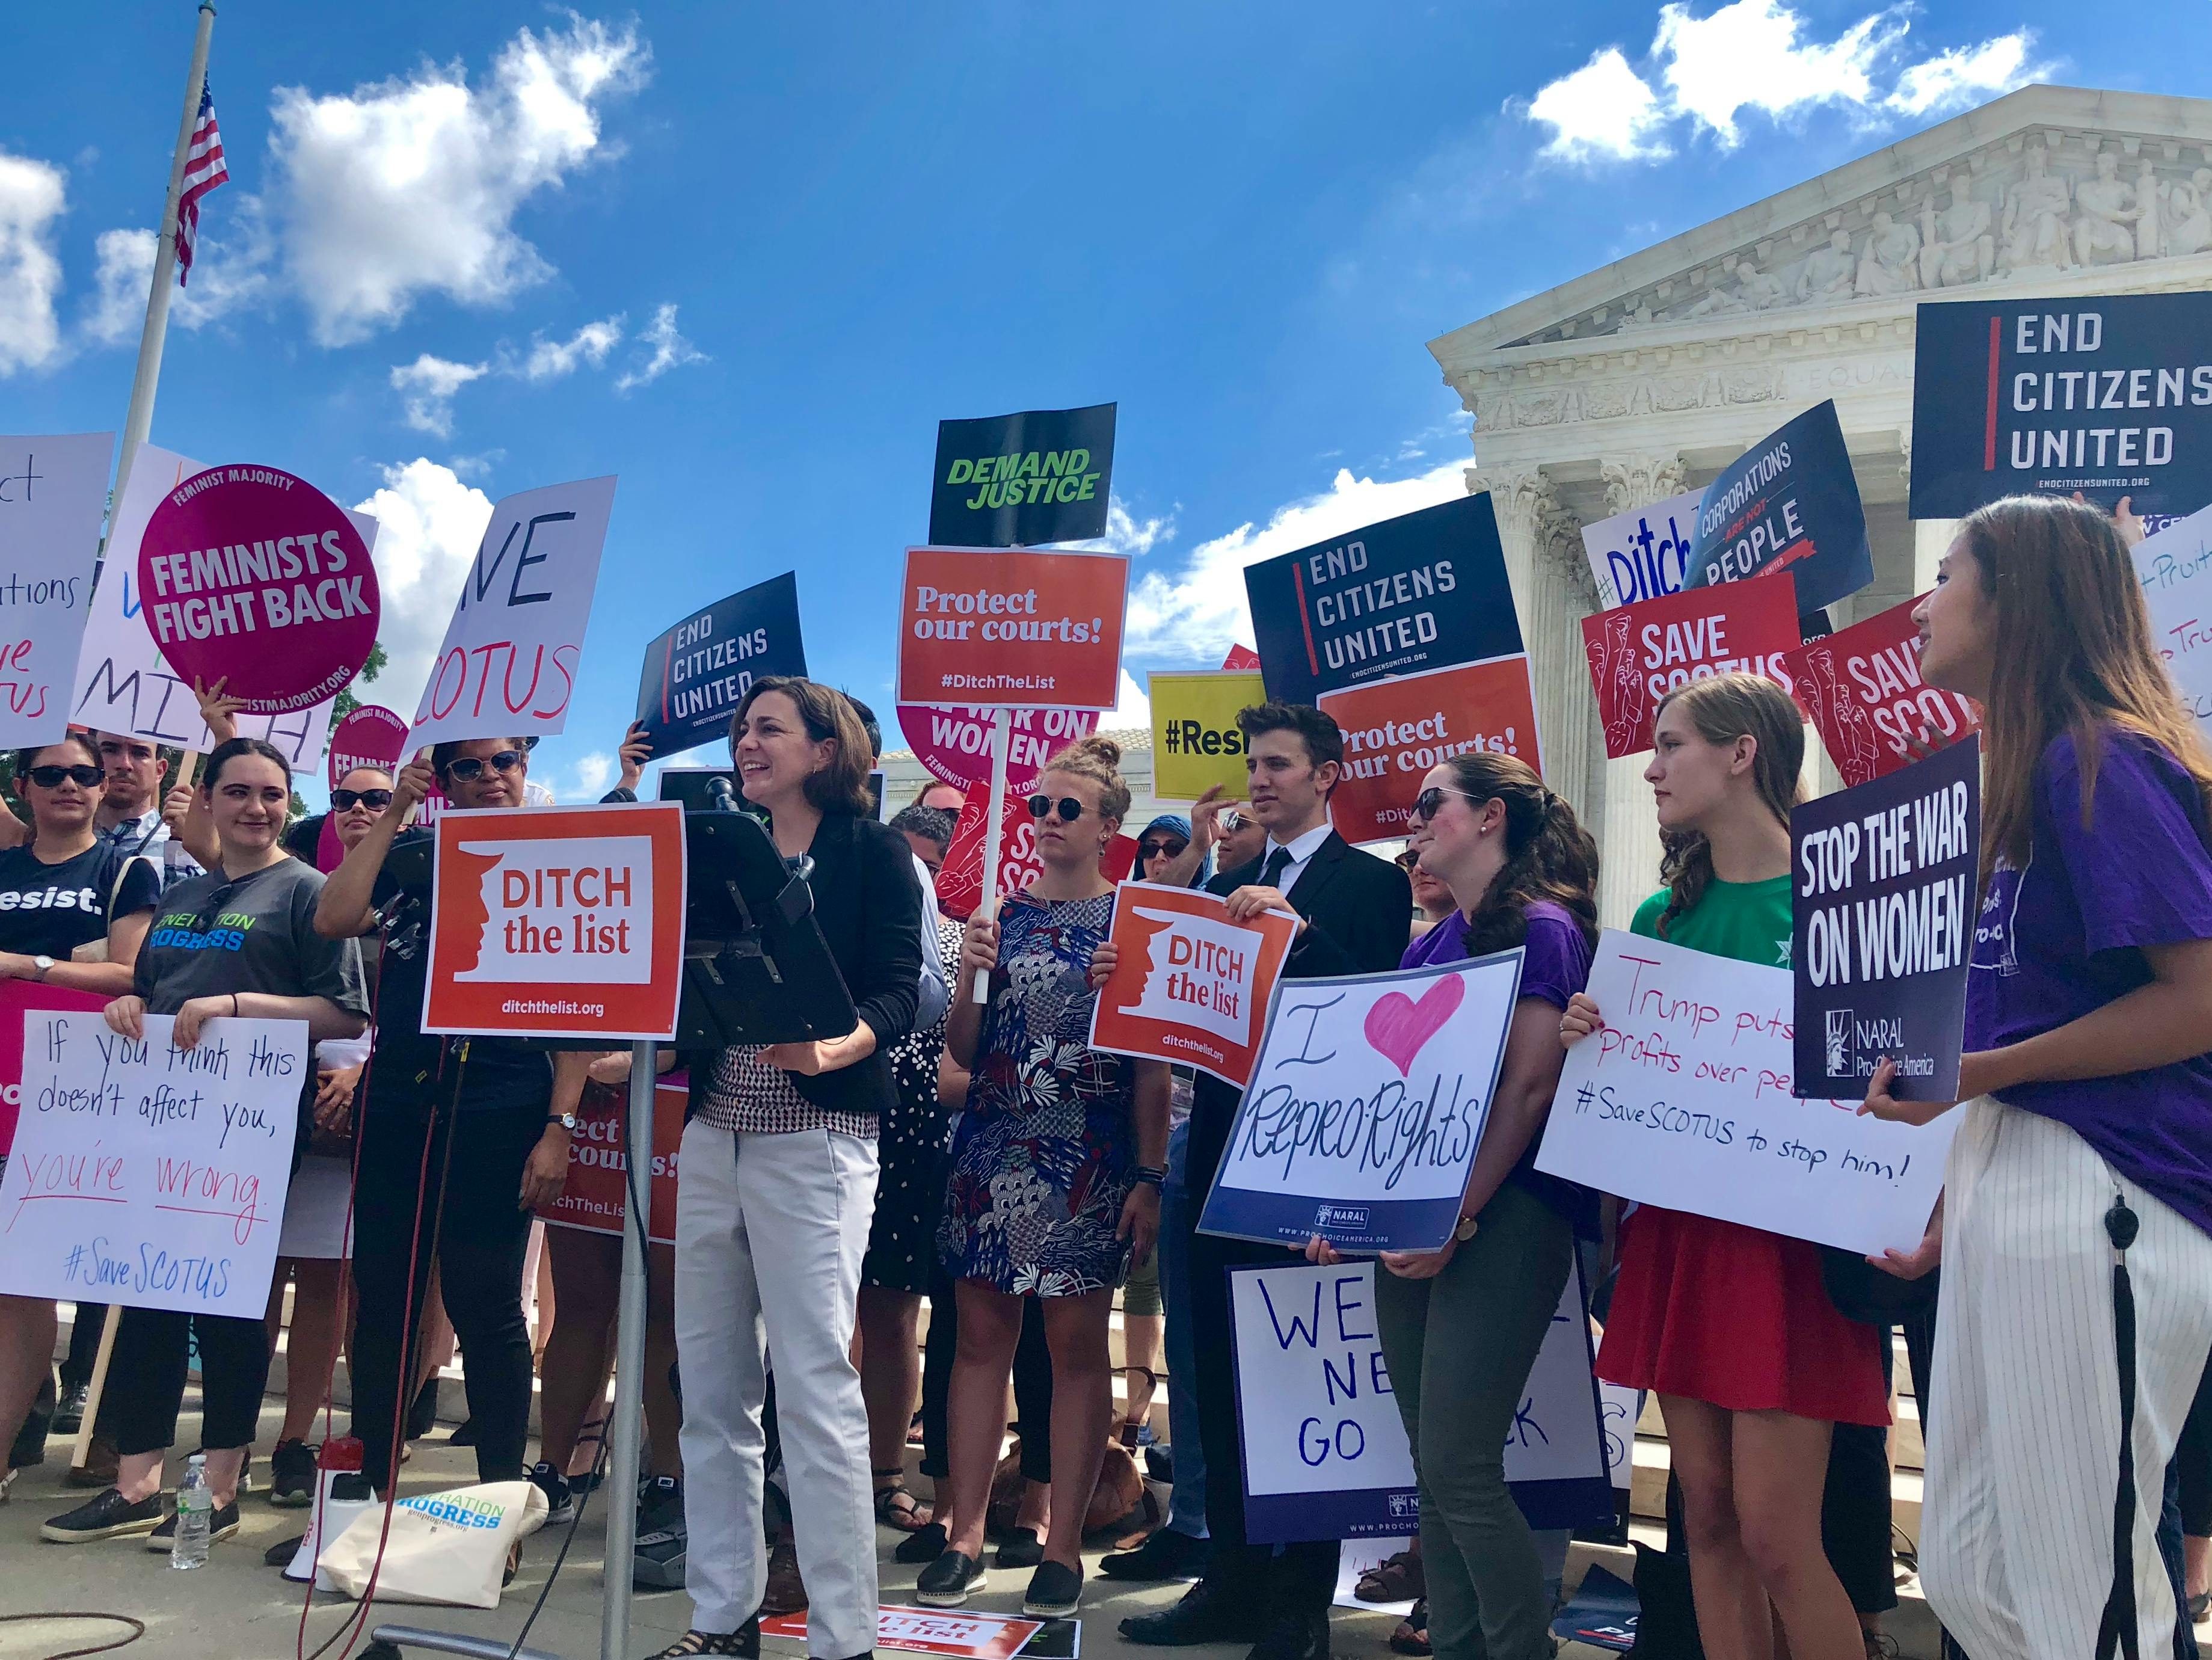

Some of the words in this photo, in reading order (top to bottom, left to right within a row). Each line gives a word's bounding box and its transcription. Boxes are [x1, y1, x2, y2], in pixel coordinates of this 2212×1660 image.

[2017, 312, 2103, 353] END
[1810, 361, 1915, 389] EQUAL
[2013, 365, 2212, 412] CITIZENS
[946, 449, 1090, 484] DEMAND
[2011, 426, 2174, 469] UNITED
[173, 471, 224, 507] FEMINIST
[229, 468, 295, 491] MAJORITY
[966, 472, 1101, 510] JUSTICE
[1701, 441, 1792, 540] CORPORATIONS
[2038, 477, 2150, 489] ENDCITIZENSUNITED.ORG
[1724, 518, 1744, 543] ARE
[1747, 497, 1767, 523] NOT
[461, 512, 576, 611] VE
[1706, 497, 1805, 586] PEOPLE
[150, 530, 348, 596] FEMINISTS
[1310, 541, 1368, 585] END
[1764, 557, 1784, 576] UNITED
[153, 591, 256, 644] FIGHT
[262, 575, 372, 629] BACK
[915, 586, 1037, 615] Protect
[1316, 560, 1456, 627] CITIZENS
[677, 613, 713, 650] END
[914, 619, 974, 641] our
[982, 617, 1102, 644] courts!
[1324, 611, 1438, 669] UNITED
[1641, 613, 1730, 669] SAVE
[2169, 618, 2212, 653] Tru
[674, 628, 768, 684] CITIZENS
[1351, 653, 1428, 679] ENDCITIZENSUNITED.ORG
[1847, 636, 1923, 704] SAV
[218, 664, 351, 712] ISTMAJORITY.ORG
[415, 641, 580, 727] OTUS
[674, 671, 754, 719] UNITED
[941, 674, 1055, 690] #DitchTheList
[349, 708, 375, 725] FEMINIST
[375, 709, 404, 732] MAJORITY
[692, 708, 737, 727] ENDCITIZENSUNITED
[1044, 710, 1089, 741] ON
[1166, 719, 1250, 755] #Res
[1873, 689, 1980, 753] SCO
[1338, 754, 1389, 782] our
[1801, 822, 1860, 898] STOP
[1864, 802, 1912, 883] THE
[1915, 781, 1968, 869] WAR
[0, 887, 102, 915] esist.
[503, 867, 631, 908] DITCH
[503, 914, 563, 954] the
[573, 913, 631, 954] list
[1807, 904, 1851, 988] ON
[1857, 873, 1965, 982] WOMEN
[1168, 935, 1244, 984] DITCH
[502, 1000, 604, 1017] ditchthelist.org
[1167, 972, 1209, 1007] the
[1212, 981, 1240, 1020] list
[1618, 954, 1720, 1039] Trump
[1731, 1008, 1794, 1047] puts
[1163, 1034, 1224, 1063] ditchthelist.org
[1275, 992, 1347, 1070] I
[1856, 1017, 1904, 1050] NARAL
[48, 1019, 69, 1063] If
[96, 1034, 148, 1091] you
[166, 1034, 230, 1080] think
[249, 1034, 295, 1077] this
[1695, 1062, 1748, 1083] over
[1857, 1054, 1903, 1077] Pro-Cce
[1903, 1053, 1934, 1075] America
[38, 1075, 124, 1116] doesn't
[139, 1084, 204, 1127] affect
[223, 1102, 276, 1149] you,
[1575, 1080, 1735, 1145] #SaveSCOTUS
[1747, 1128, 1767, 1152] to
[1777, 1139, 1828, 1173] stop
[1841, 1149, 1911, 1187] him!
[568, 1144, 678, 1178] cous!
[6, 1140, 125, 1233] you're
[552, 1195, 625, 1218] chTheLis
[1333, 1210, 1365, 1222] NARAL
[64, 1237, 232, 1299] #SaveSCOTUS
[1257, 1276, 1373, 1350] WE
[1298, 1416, 1365, 1466] GO
[407, 1508, 469, 1532] genprogress.org
[878, 1616, 981, 1632] ITCH
[909, 1626, 968, 1640] list
